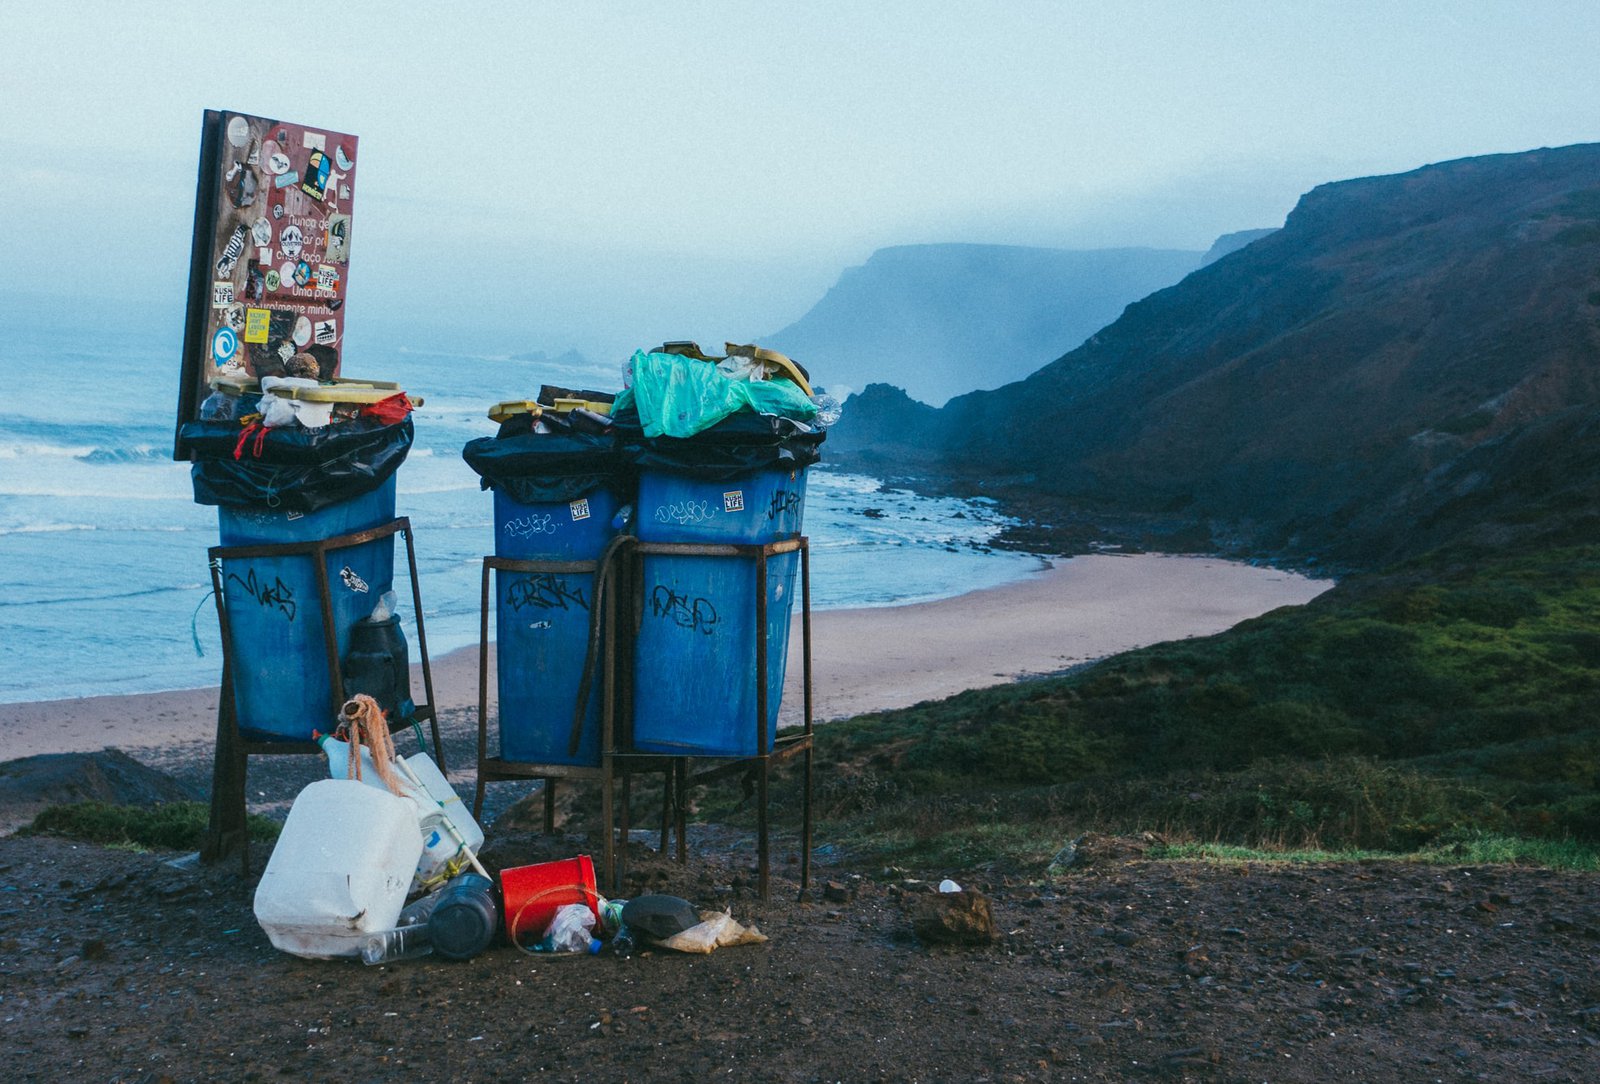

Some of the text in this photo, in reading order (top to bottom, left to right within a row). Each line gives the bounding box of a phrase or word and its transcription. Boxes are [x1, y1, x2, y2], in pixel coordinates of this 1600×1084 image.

[288, 214, 317, 227] Nunca
[318, 275, 333, 287] LIFE
[214, 287, 233, 295] KUSH
[292, 285, 313, 298] Uma
[214, 294, 233, 303] LIFE
[726, 500, 743, 508] LIFE
[572, 508, 589, 517] LIFE
